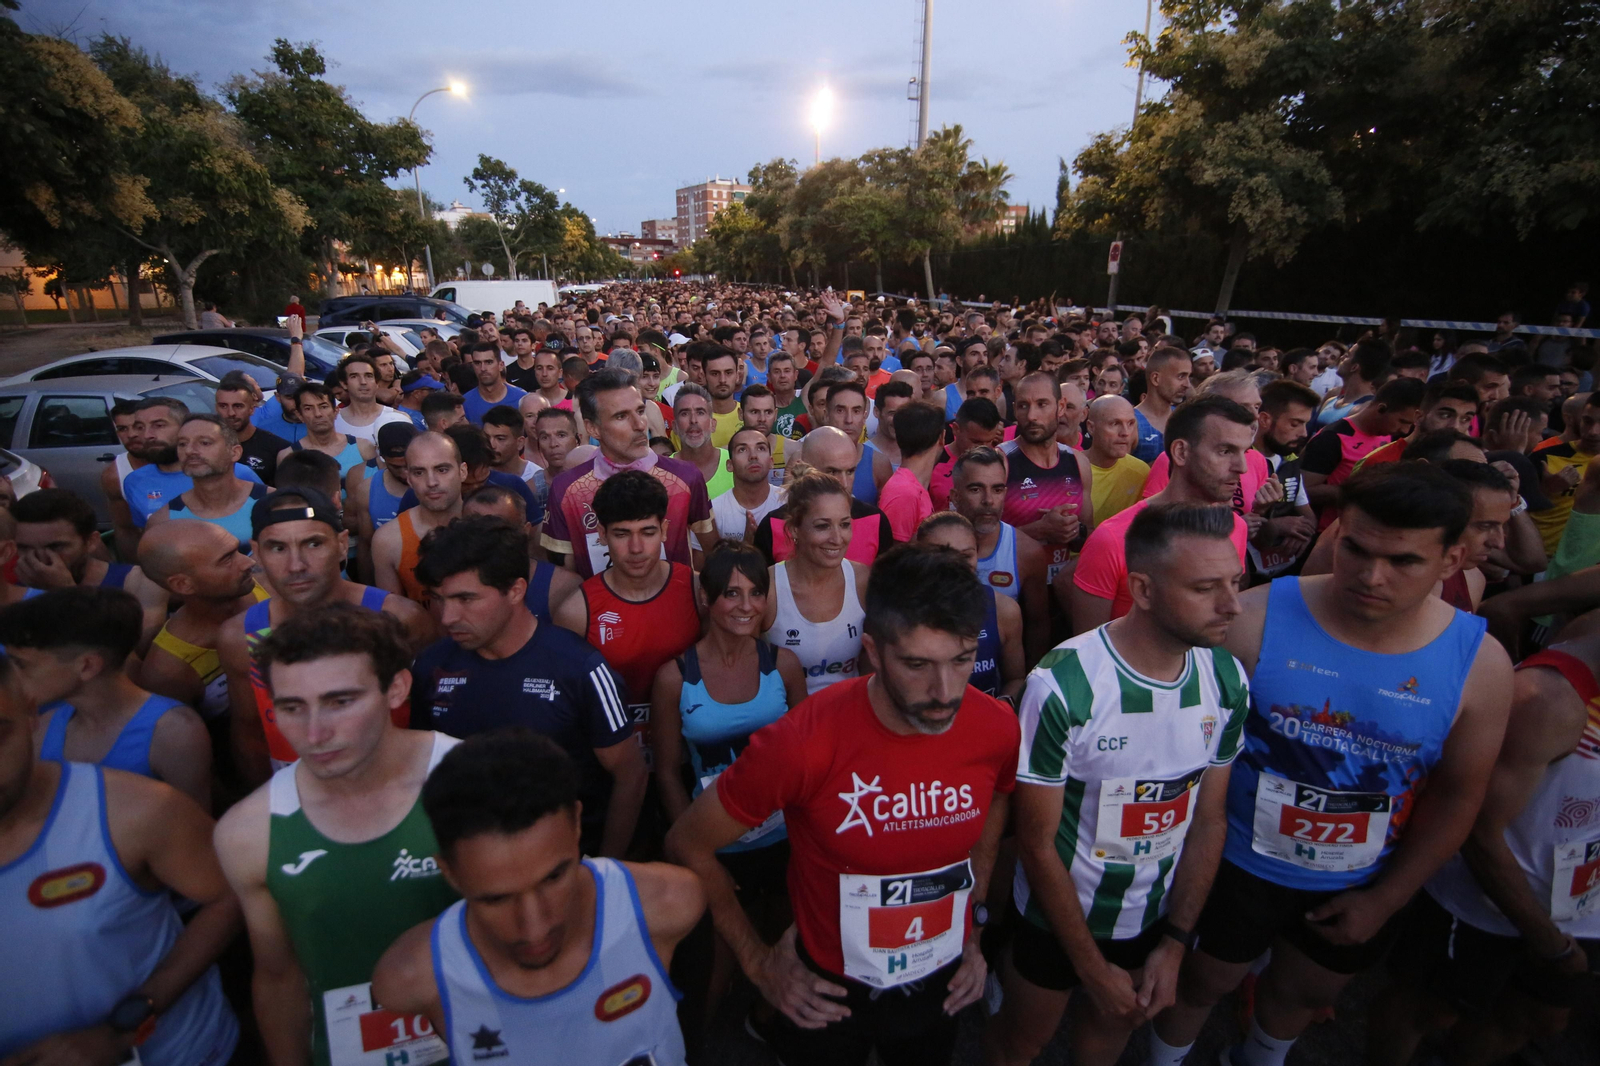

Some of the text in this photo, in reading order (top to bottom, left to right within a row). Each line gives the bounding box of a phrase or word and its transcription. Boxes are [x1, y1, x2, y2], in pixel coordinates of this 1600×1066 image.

[1266, 553, 1284, 567] 10
[972, 658, 995, 673] RRA
[438, 685, 455, 693] HALF
[439, 677, 467, 685] #BERLIN
[1378, 688, 1431, 705] TROTACALLES
[633, 707, 650, 722] 21
[1097, 736, 1128, 751] CCF
[1269, 711, 1417, 757] 20 CARRERA NOCTURNA
[873, 780, 973, 821] califas
[1138, 782, 1165, 801] 21
[1299, 789, 1328, 812] 21
[1142, 809, 1176, 835] 59
[1293, 818, 1355, 842] 272
[886, 879, 913, 905] 21
[904, 916, 924, 941] 4
